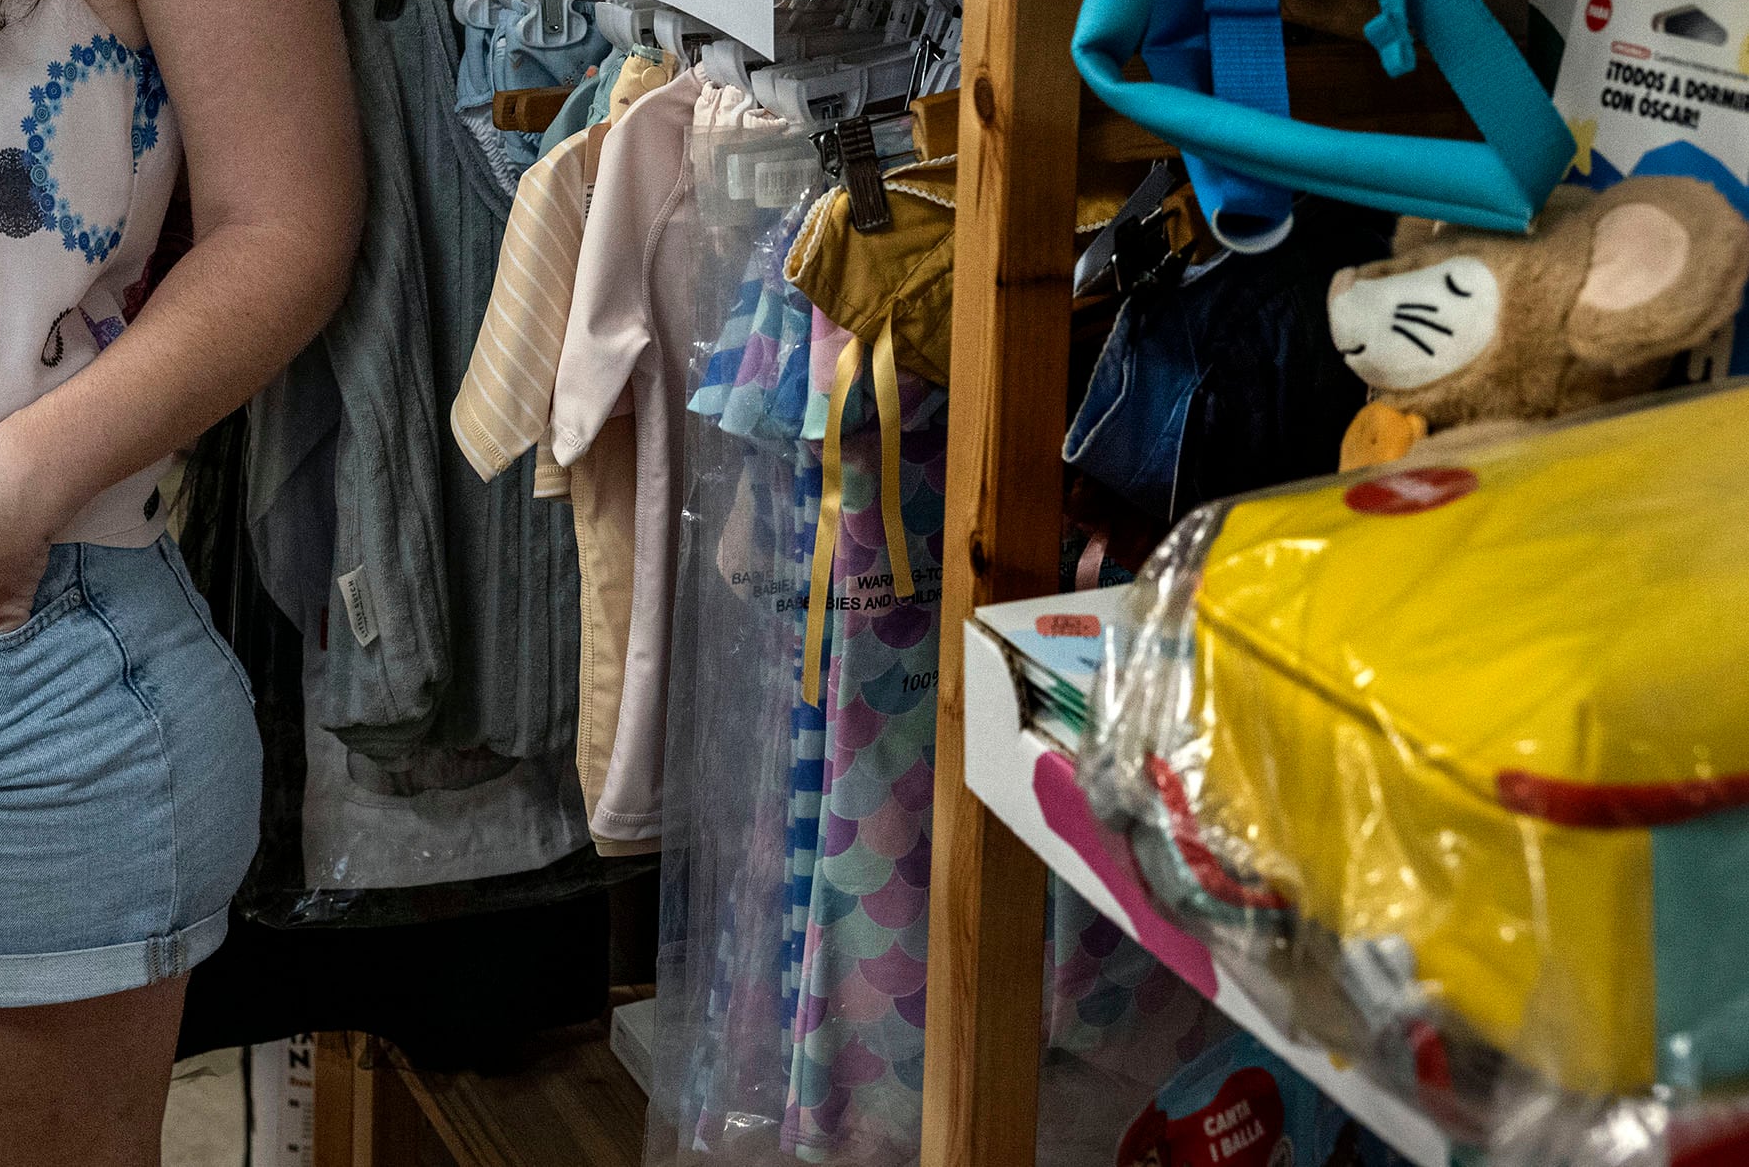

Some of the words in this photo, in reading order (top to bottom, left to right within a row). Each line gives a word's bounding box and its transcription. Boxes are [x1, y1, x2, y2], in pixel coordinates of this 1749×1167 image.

[1606, 59, 1666, 92] ¡TODOS
[1668, 76, 1680, 96] A
[1601, 87, 1635, 112] CON
[1638, 92, 1701, 130] ÓSCAR!
[864, 593, 891, 611] AND
